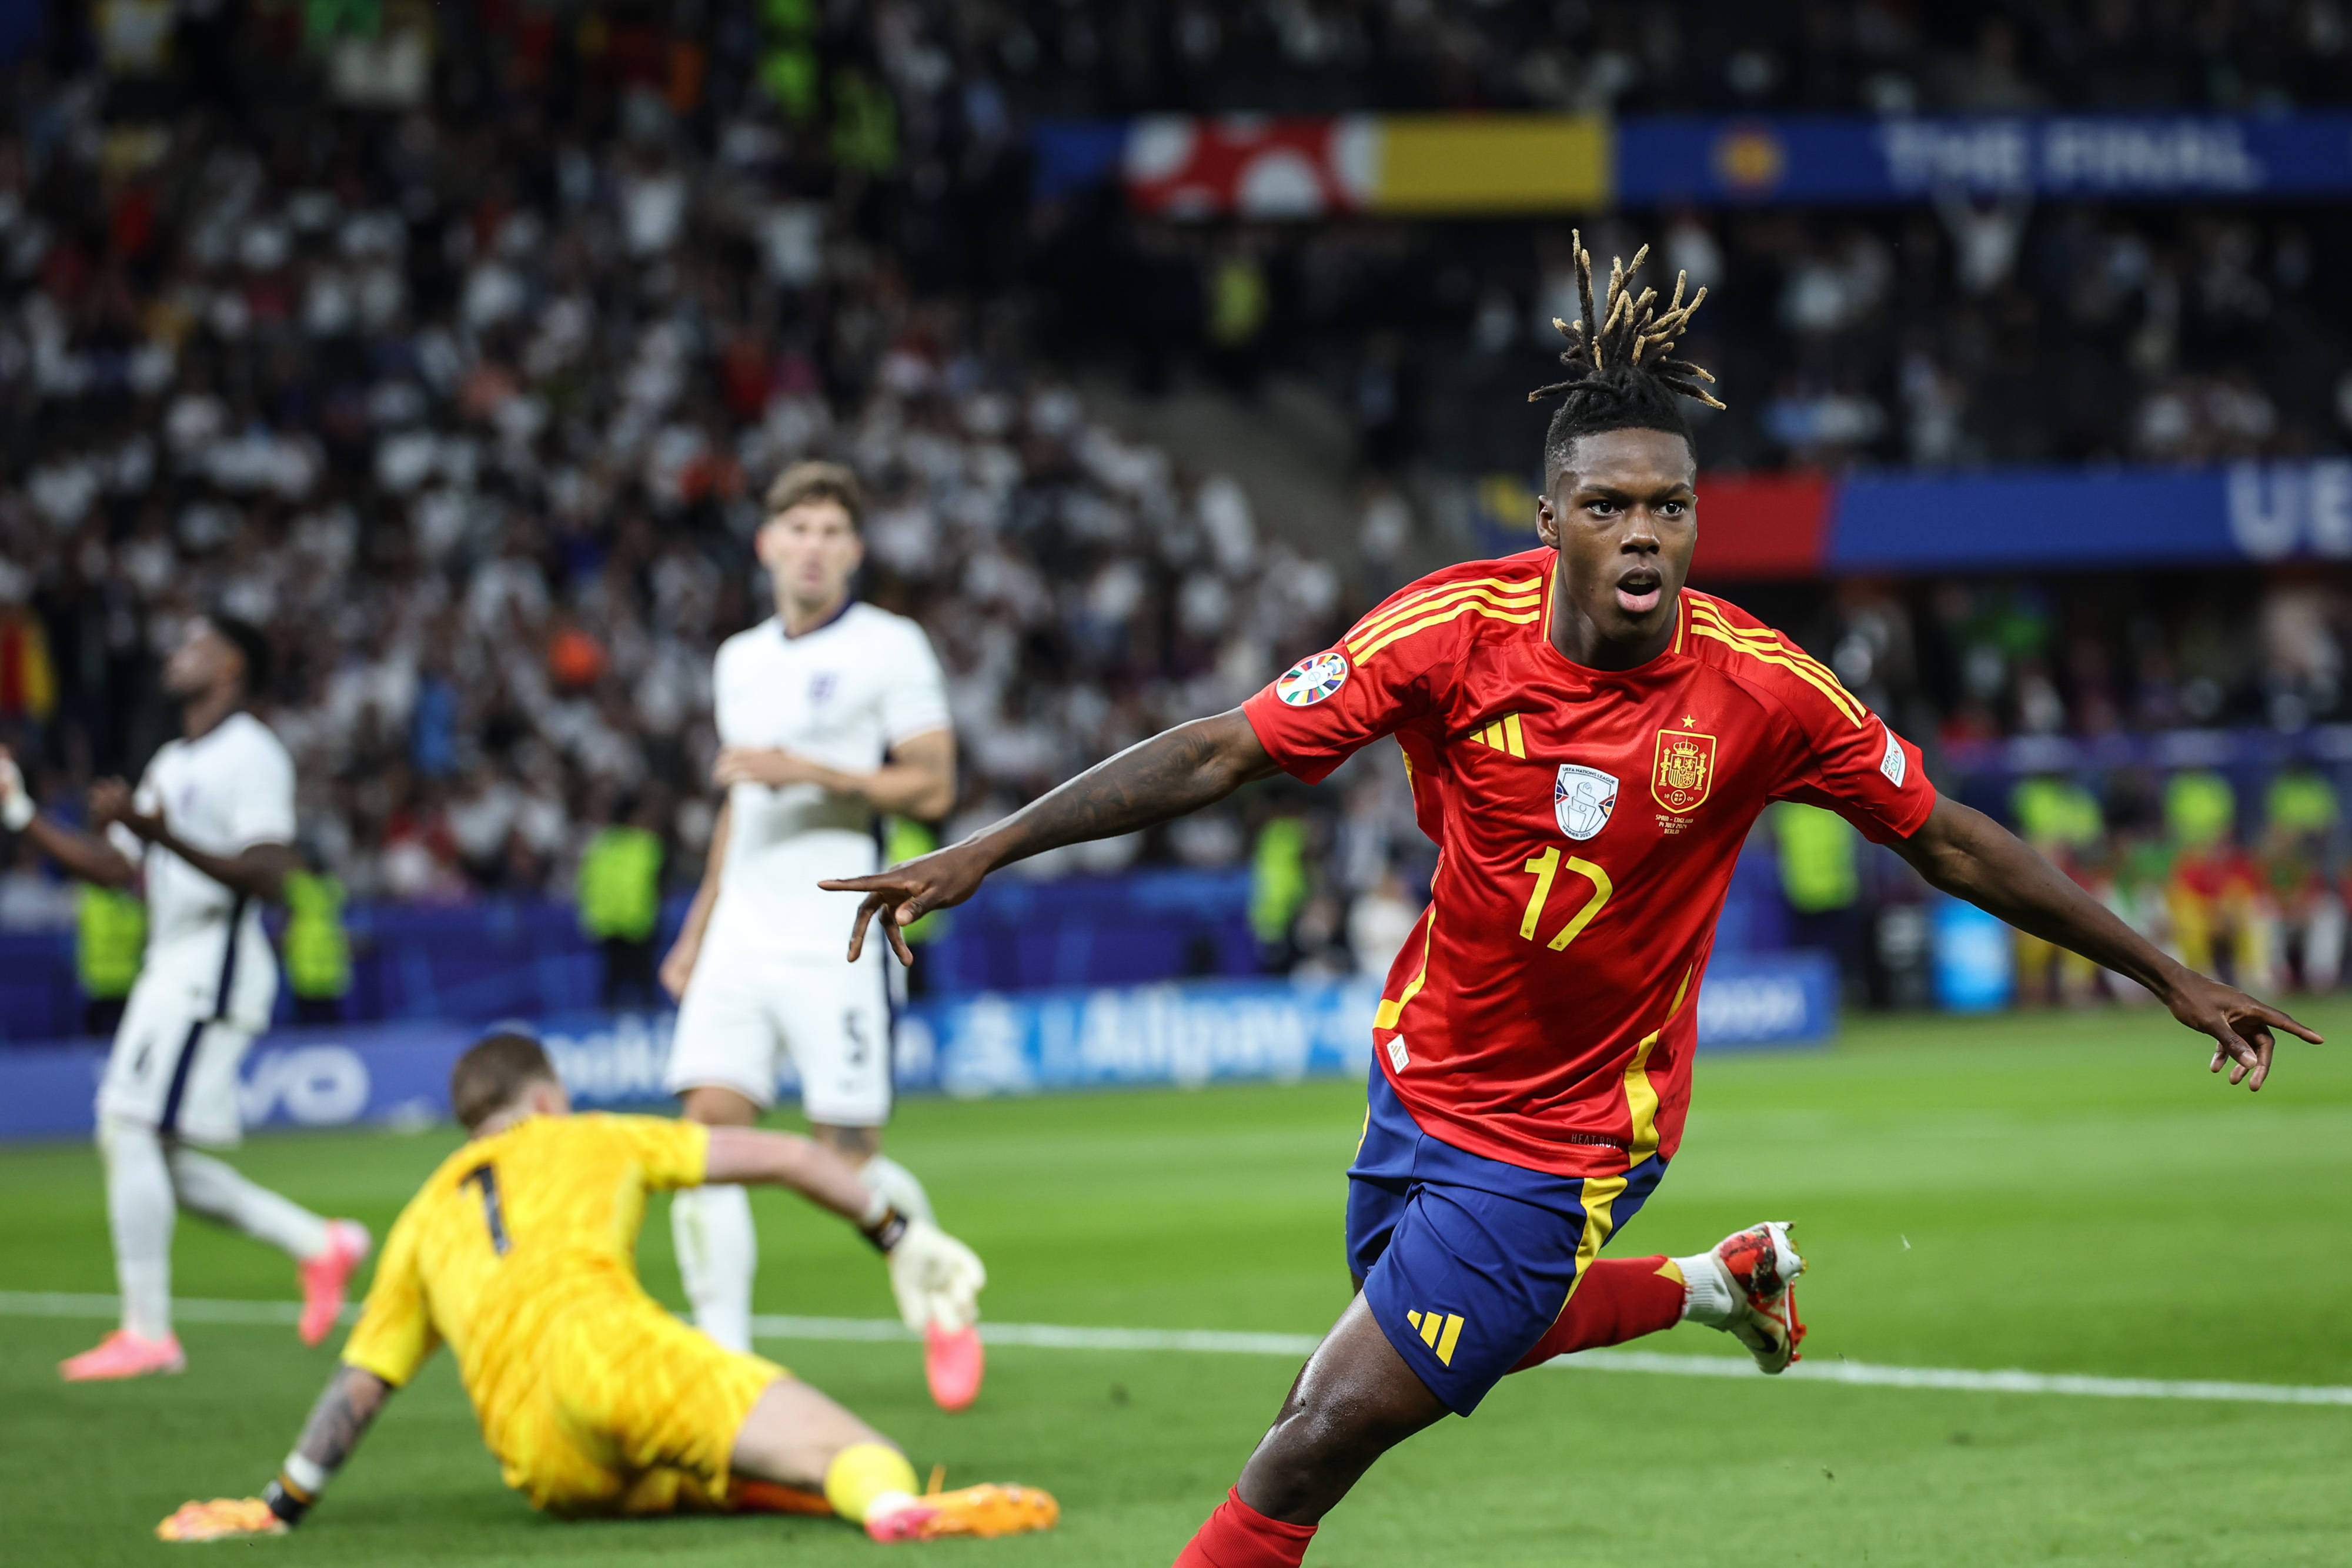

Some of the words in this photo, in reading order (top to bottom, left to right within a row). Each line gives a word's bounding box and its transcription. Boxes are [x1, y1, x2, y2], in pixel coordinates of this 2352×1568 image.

[1886, 119, 2024, 185] THE
[2046, 119, 2259, 185] FINAL
[1597, 774, 1615, 784] LEAGUE
[1562, 824, 1579, 838] WINNER
[1519, 845, 1613, 952] 17
[841, 1007, 870, 1070] 5
[1571, 1133, 1618, 1150] HEAT.RDY
[456, 1163, 513, 1257] 1
